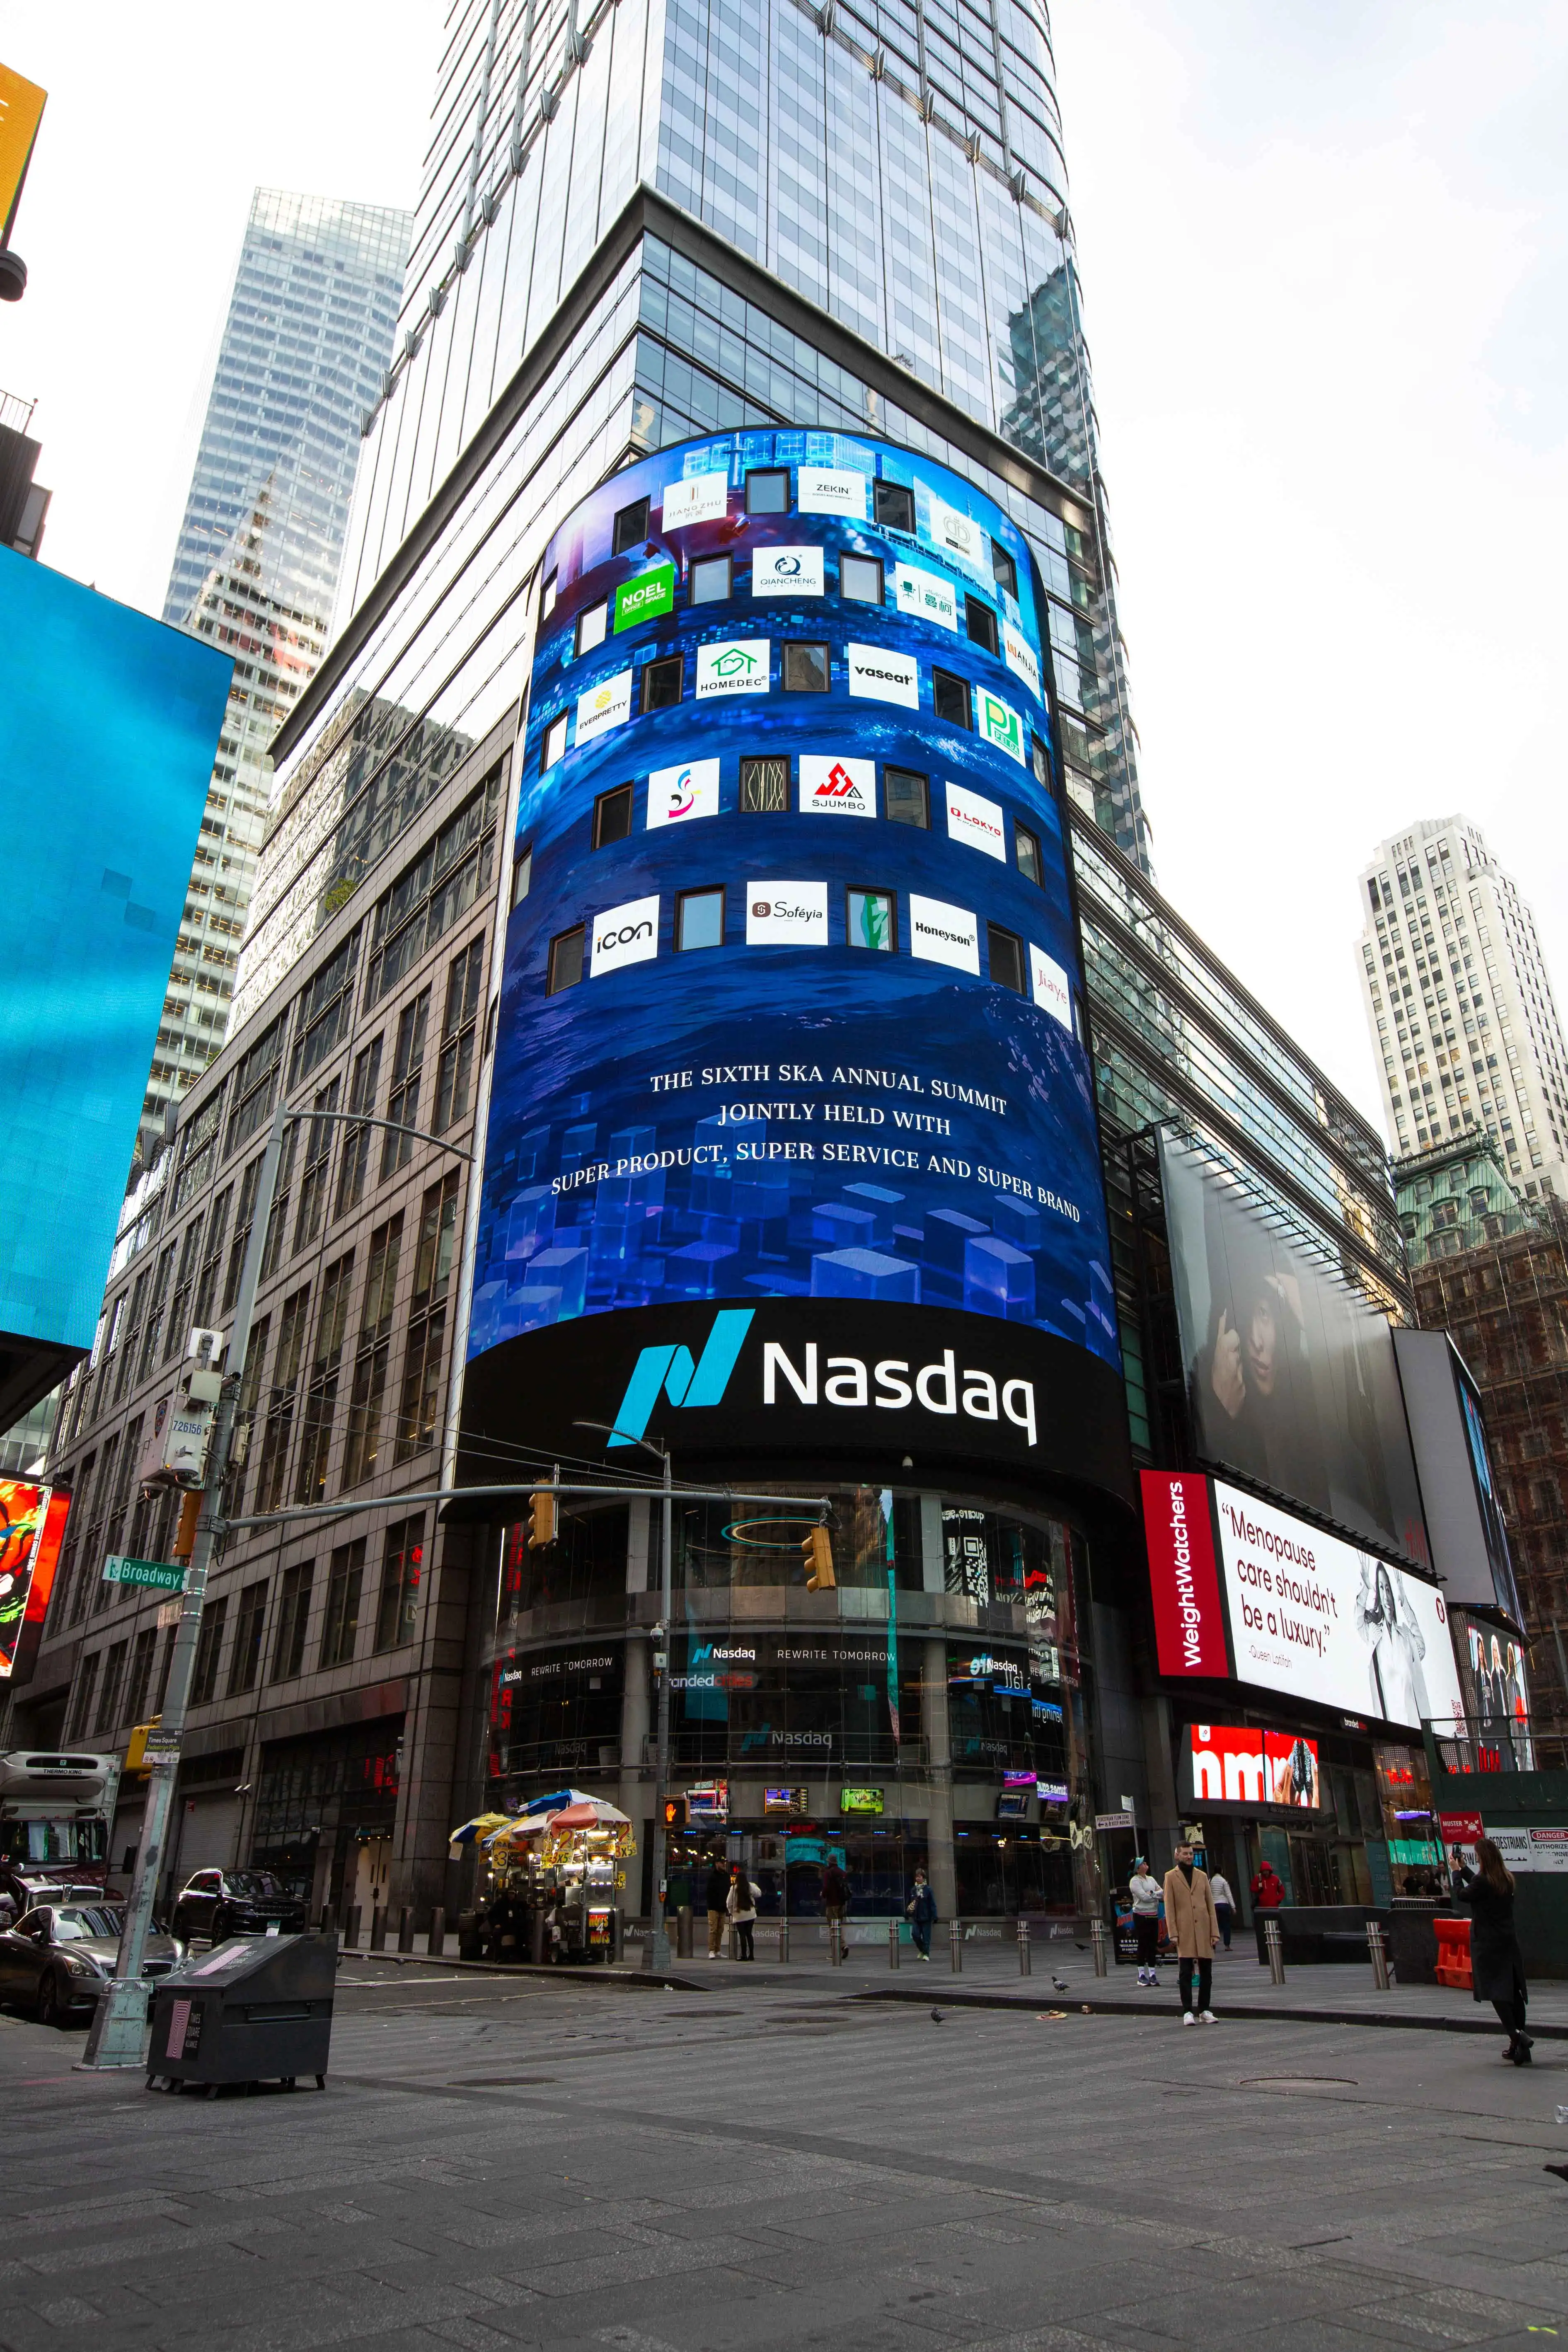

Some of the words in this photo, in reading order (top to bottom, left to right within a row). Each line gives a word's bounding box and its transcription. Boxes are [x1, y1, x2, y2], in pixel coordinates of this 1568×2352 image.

[816, 484, 849, 494] ZEKIN
[669, 506, 698, 518] JIANG
[700, 500, 721, 509] ZHU
[622, 582, 666, 609] NOEL
[645, 592, 666, 604] SPACE
[854, 665, 911, 685] vaseat
[580, 700, 627, 729] EVERPRETTY
[811, 799, 866, 811] SJUMBO
[773, 901, 823, 922] Soféyia
[651, 1070, 693, 1092] THE
[701, 1065, 769, 1085] SIXTH
[779, 1065, 824, 1082] SKA
[831, 1067, 924, 1094] ANNUAL
[931, 1079, 1007, 1115] SUMMIT
[717, 1103, 815, 1126] JOINTLY
[824, 1104, 885, 1125] HELD
[893, 1111, 951, 1136] WITH
[551, 1163, 610, 1195] SUPER
[616, 1144, 728, 1177] PRODUCT,
[736, 1142, 814, 1160] SUPER
[822, 1143, 920, 1169] SERVICE
[927, 1154, 971, 1178] AND
[978, 1165, 1033, 1199] SUPER
[1037, 1186, 1080, 1223] BRAND
[763, 1342, 1038, 1447] Nasdaq
[121, 1561, 180, 1590] Broadway
[1170, 1481, 1202, 1667] WeightWatchers
[1237, 1559, 1272, 1592] care
[1275, 1568, 1338, 1618] shouldn't
[1241, 1593, 1263, 1631] be
[1267, 1612, 1278, 1636] a
[713, 1647, 755, 1661] Nasdaq
[777, 1650, 827, 1659] REWRITE
[832, 1651, 895, 1661] TOMORROW
[504, 1670, 522, 1683] Nasdaq
[531, 1663, 561, 1677] REWRITE
[987, 1660, 1018, 1675] Nasdaq
[1030, 1667, 1053, 1679] REWRIT
[1059, 1675, 1078, 1688] OMORROW
[554, 1741, 587, 1756] Nasdaq
[772, 1730, 832, 1749] Nasdaq
[981, 1742, 1007, 1756] Nasdaq
[589, 1914, 609, 1927] NUTS
[596, 1922, 604, 1934] 4
[1057, 1926, 1074, 1935] Nasdaq
[590, 1932, 610, 1944] NUTS
[977, 1928, 1002, 1938] Nasdaq
